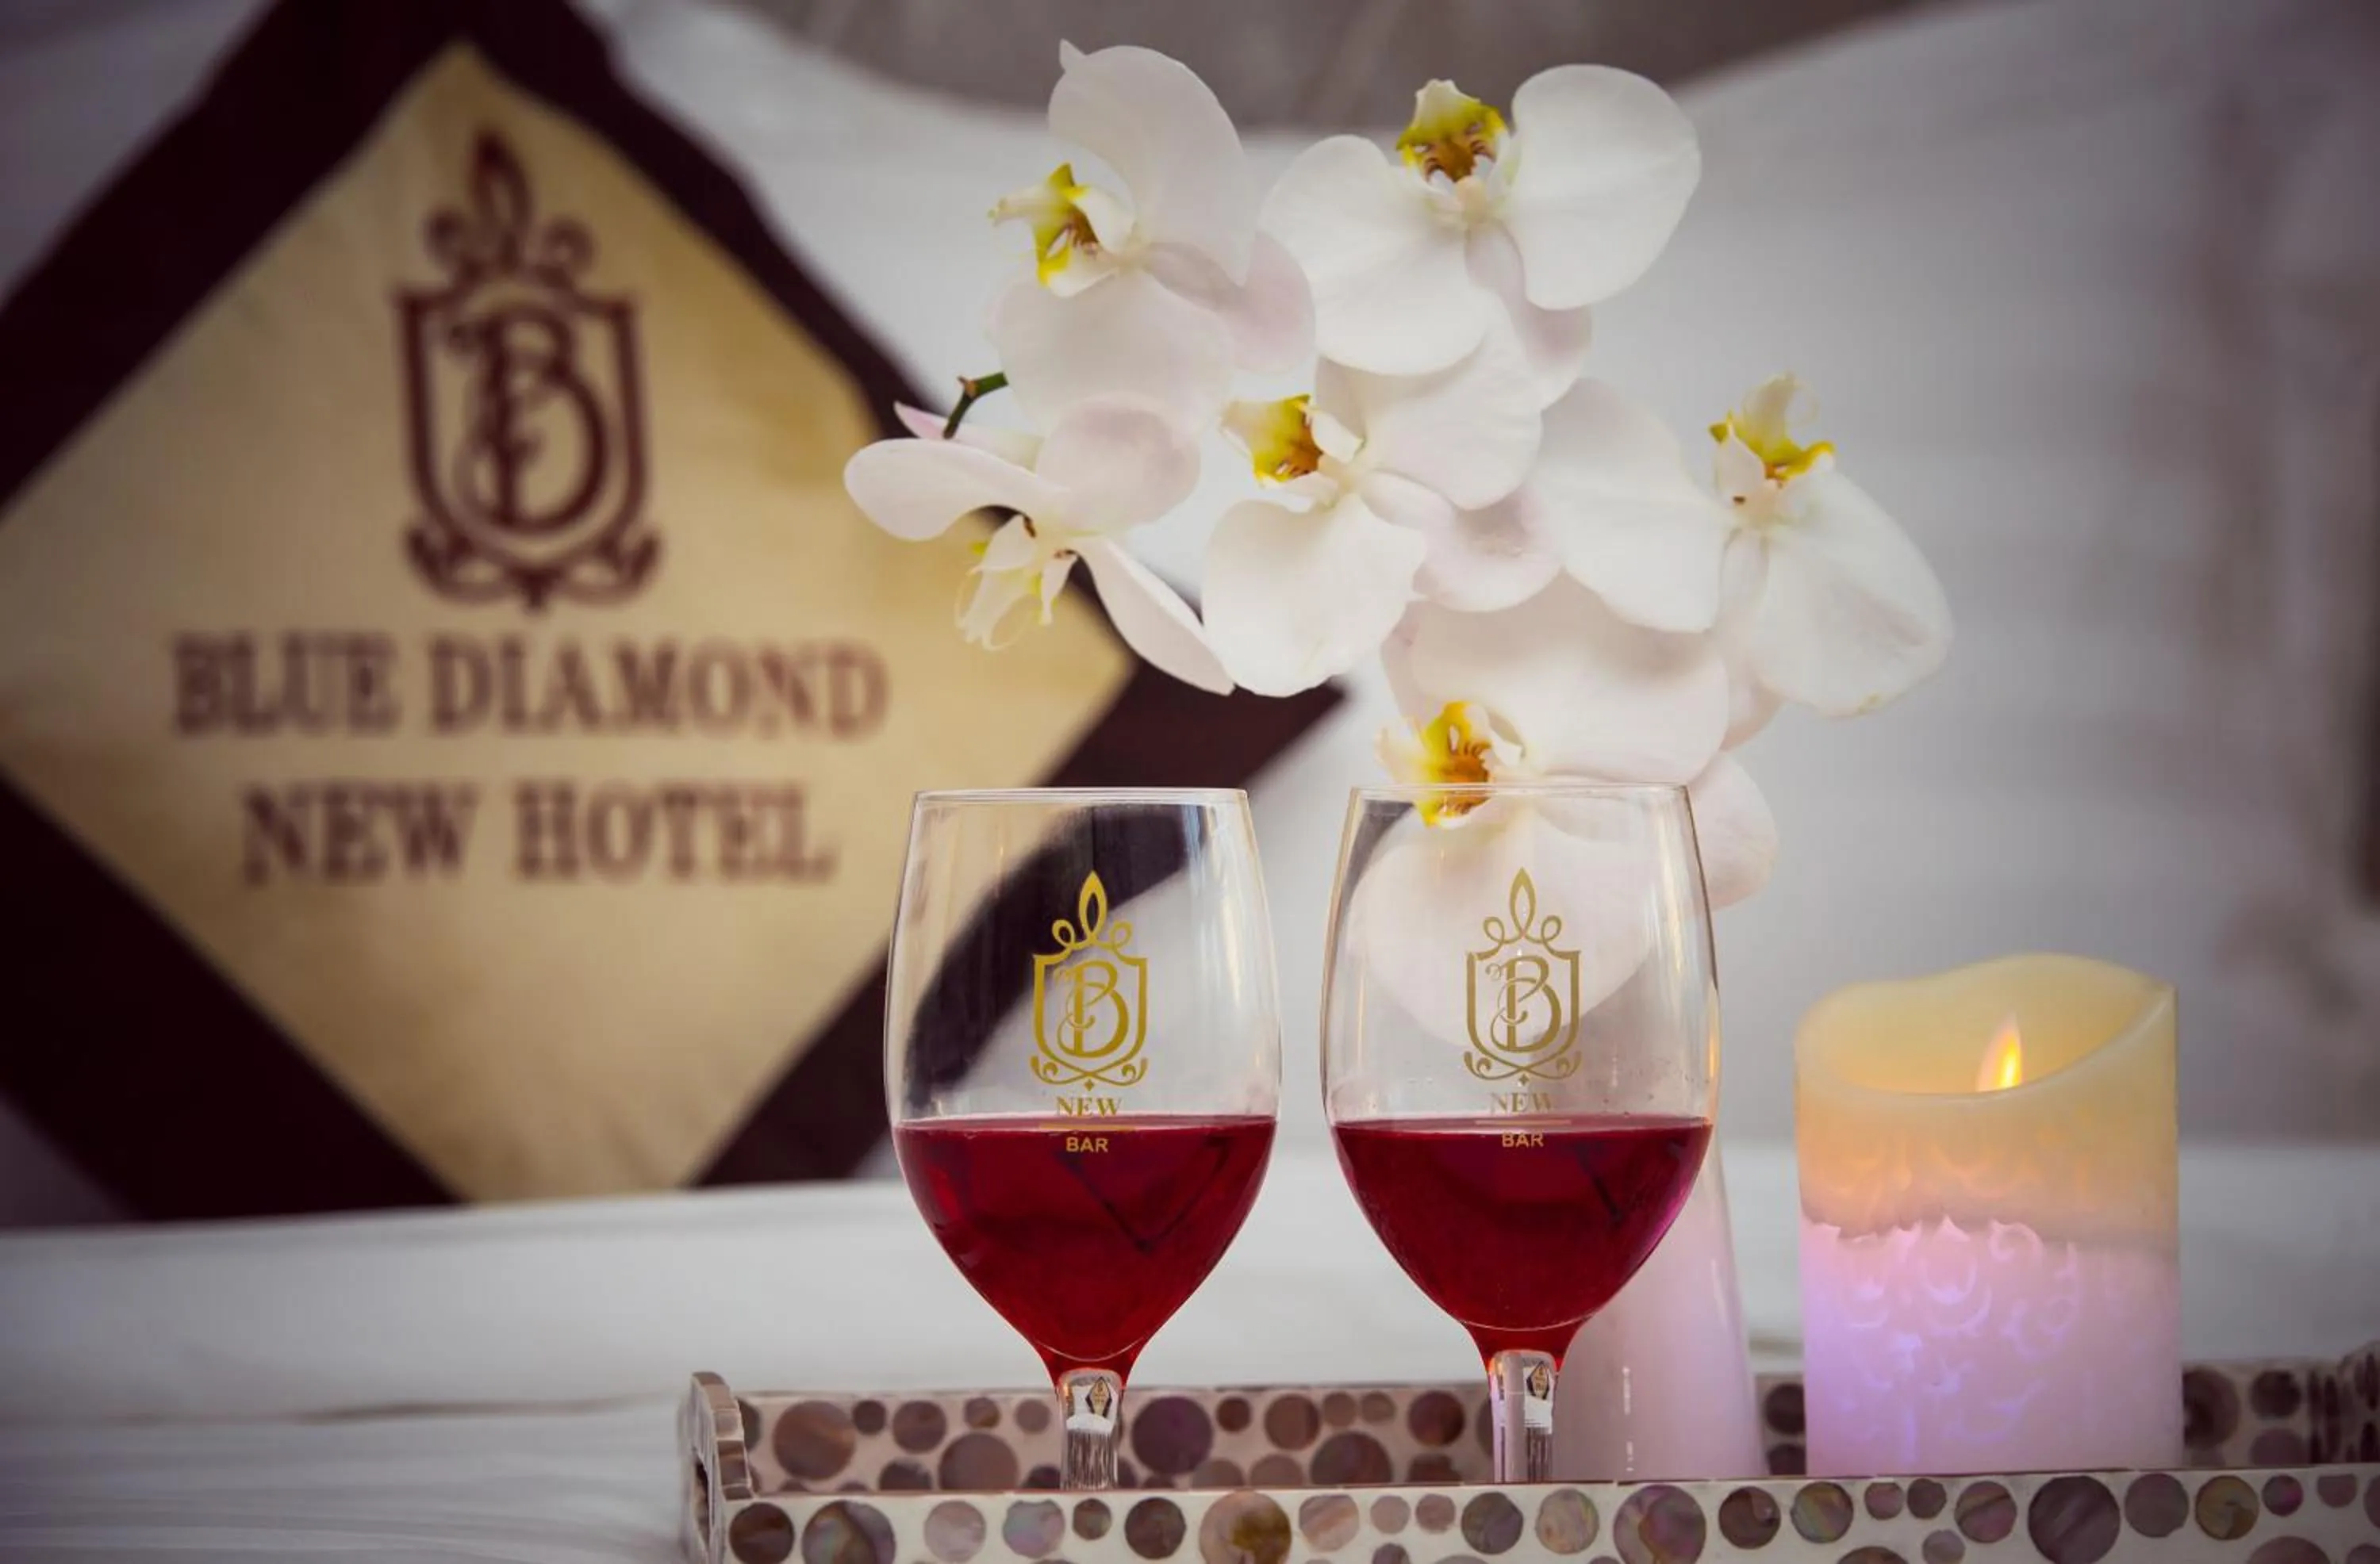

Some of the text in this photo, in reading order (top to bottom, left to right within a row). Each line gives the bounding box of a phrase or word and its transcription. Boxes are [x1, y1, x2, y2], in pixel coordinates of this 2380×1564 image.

[175, 635, 887, 739] BLUE DIAMOND
[241, 782, 837, 884] NEW HOTEL
[1056, 1096, 1121, 1117] NEW
[1489, 1092, 1553, 1113] NEW
[1066, 1137, 1108, 1152] BAR
[1502, 1132, 1544, 1148] BAR
